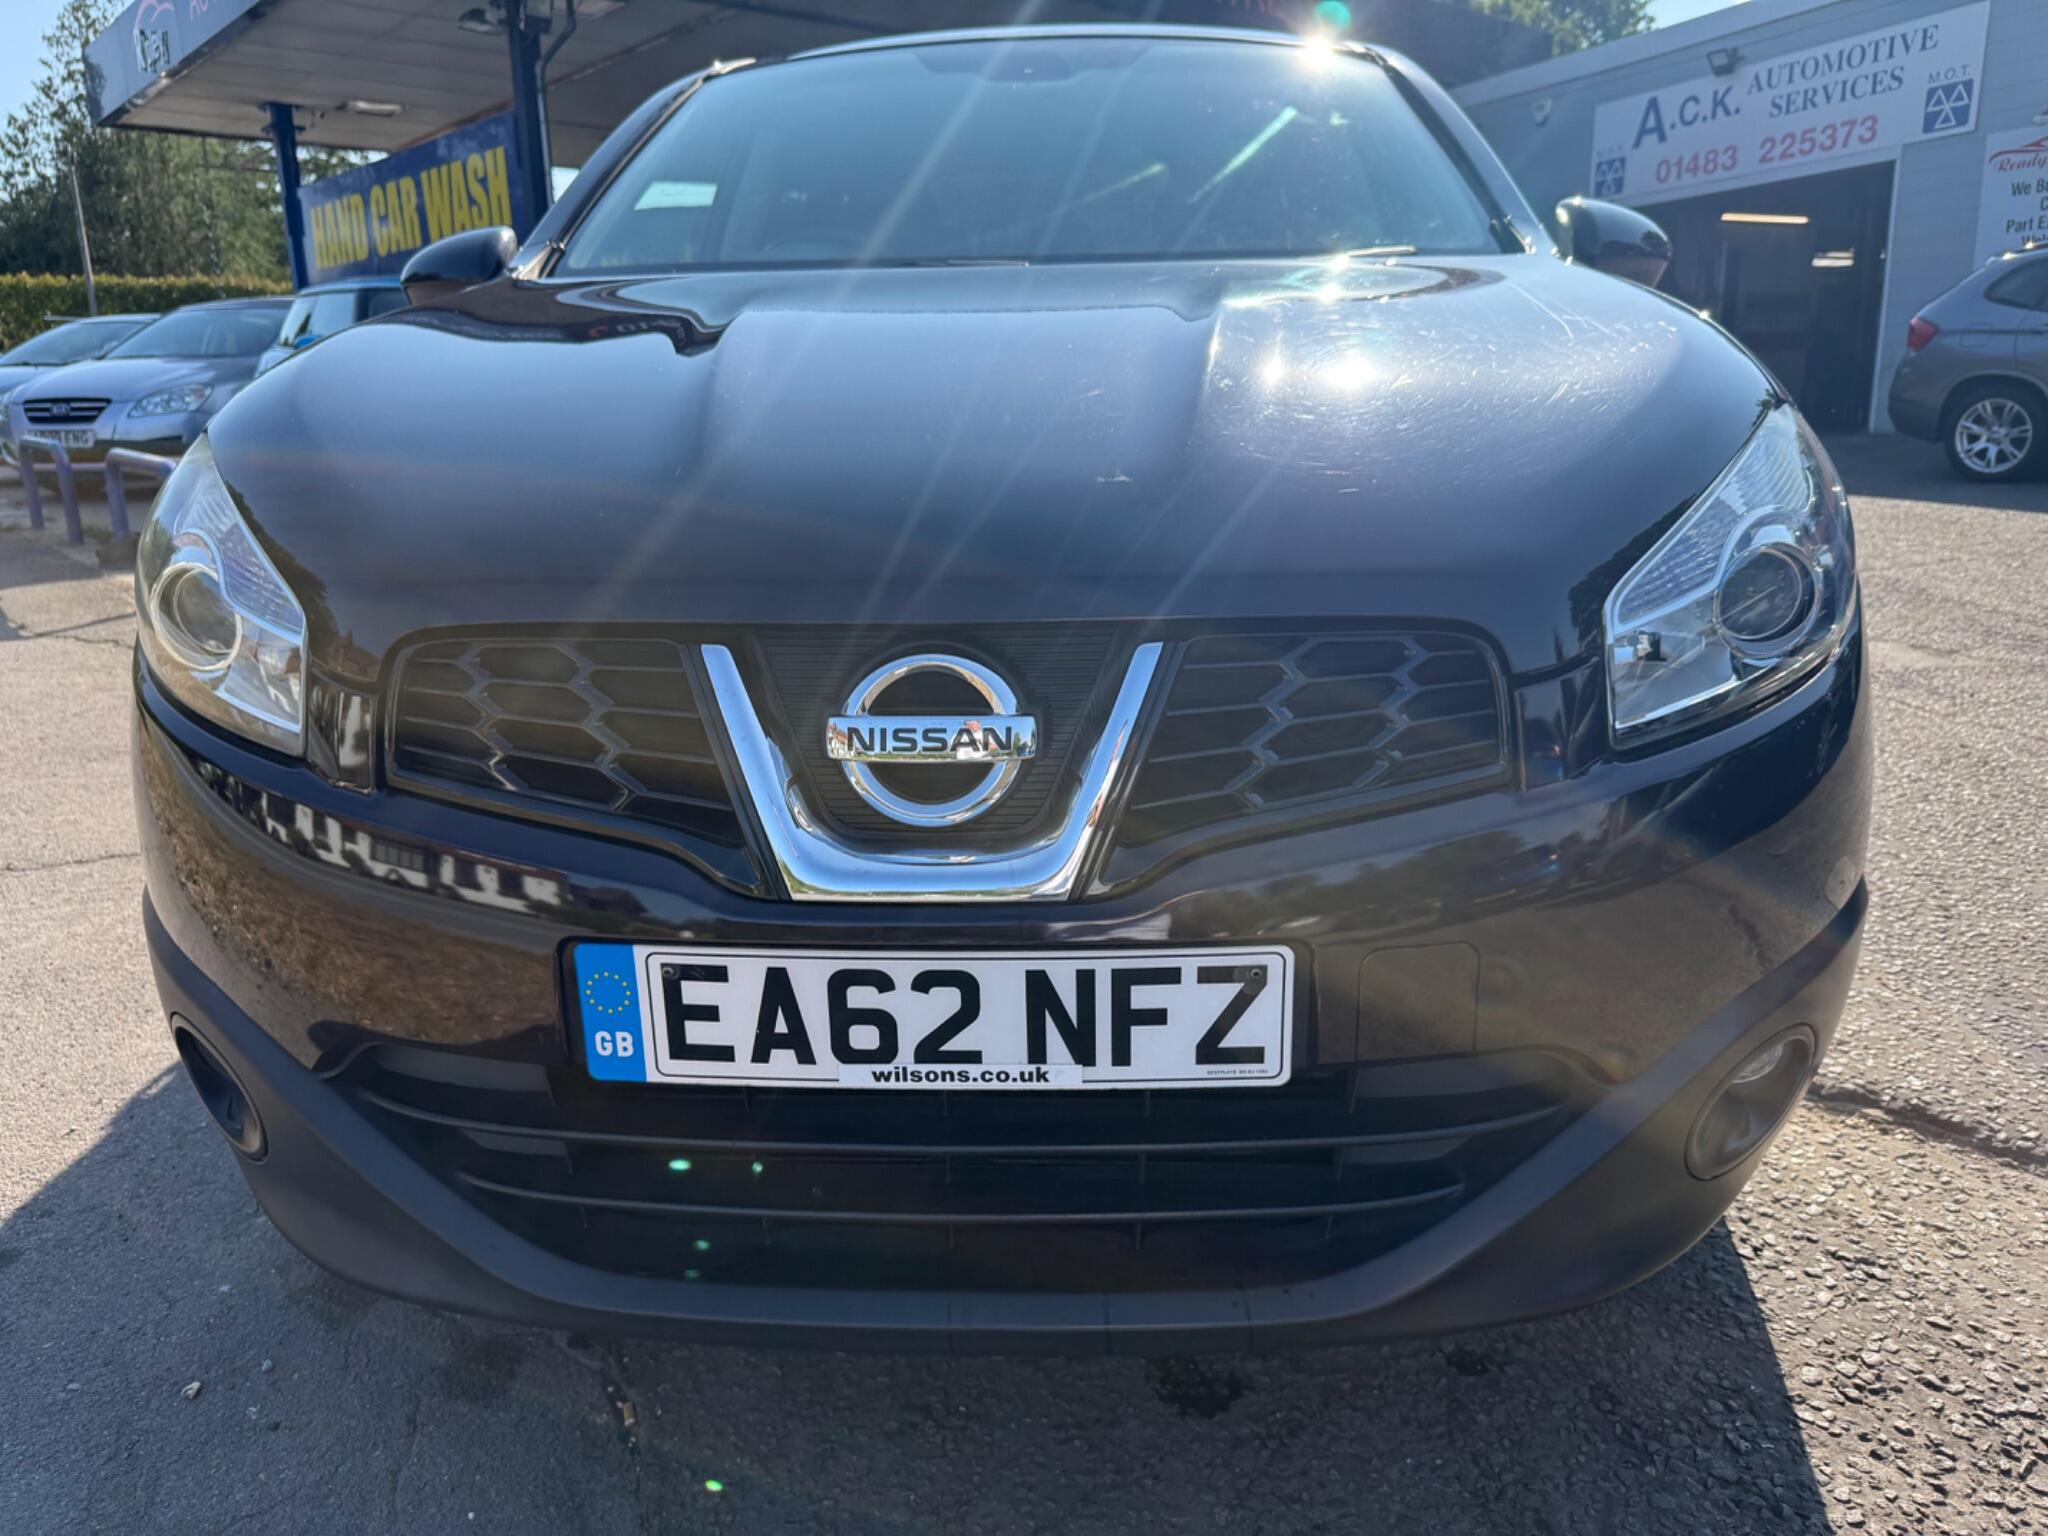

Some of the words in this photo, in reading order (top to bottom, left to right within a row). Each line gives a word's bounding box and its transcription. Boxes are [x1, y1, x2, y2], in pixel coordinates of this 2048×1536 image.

[1747, 24, 1939, 95] AUTOMOTIVE
[1631, 84, 1740, 150] A.C.K.
[1768, 65, 1905, 119] SERVICES
[1655, 144, 1738, 185] 01483
[1758, 114, 1879, 165] 225373
[310, 193, 369, 270] HAND
[370, 175, 422, 257] CAR
[420, 145, 513, 243] WASH
[2011, 181, 2033, 197] We
[2006, 217, 2034, 234] Part
[2038, 214, 2048, 230] E
[847, 726, 1012, 752] NISSAN
[660, 962, 983, 1066] EA62
[1025, 964, 1268, 1067] NFZ
[595, 1030, 634, 1058] GB
[871, 1066, 1050, 1083] wilsons.co.uk
